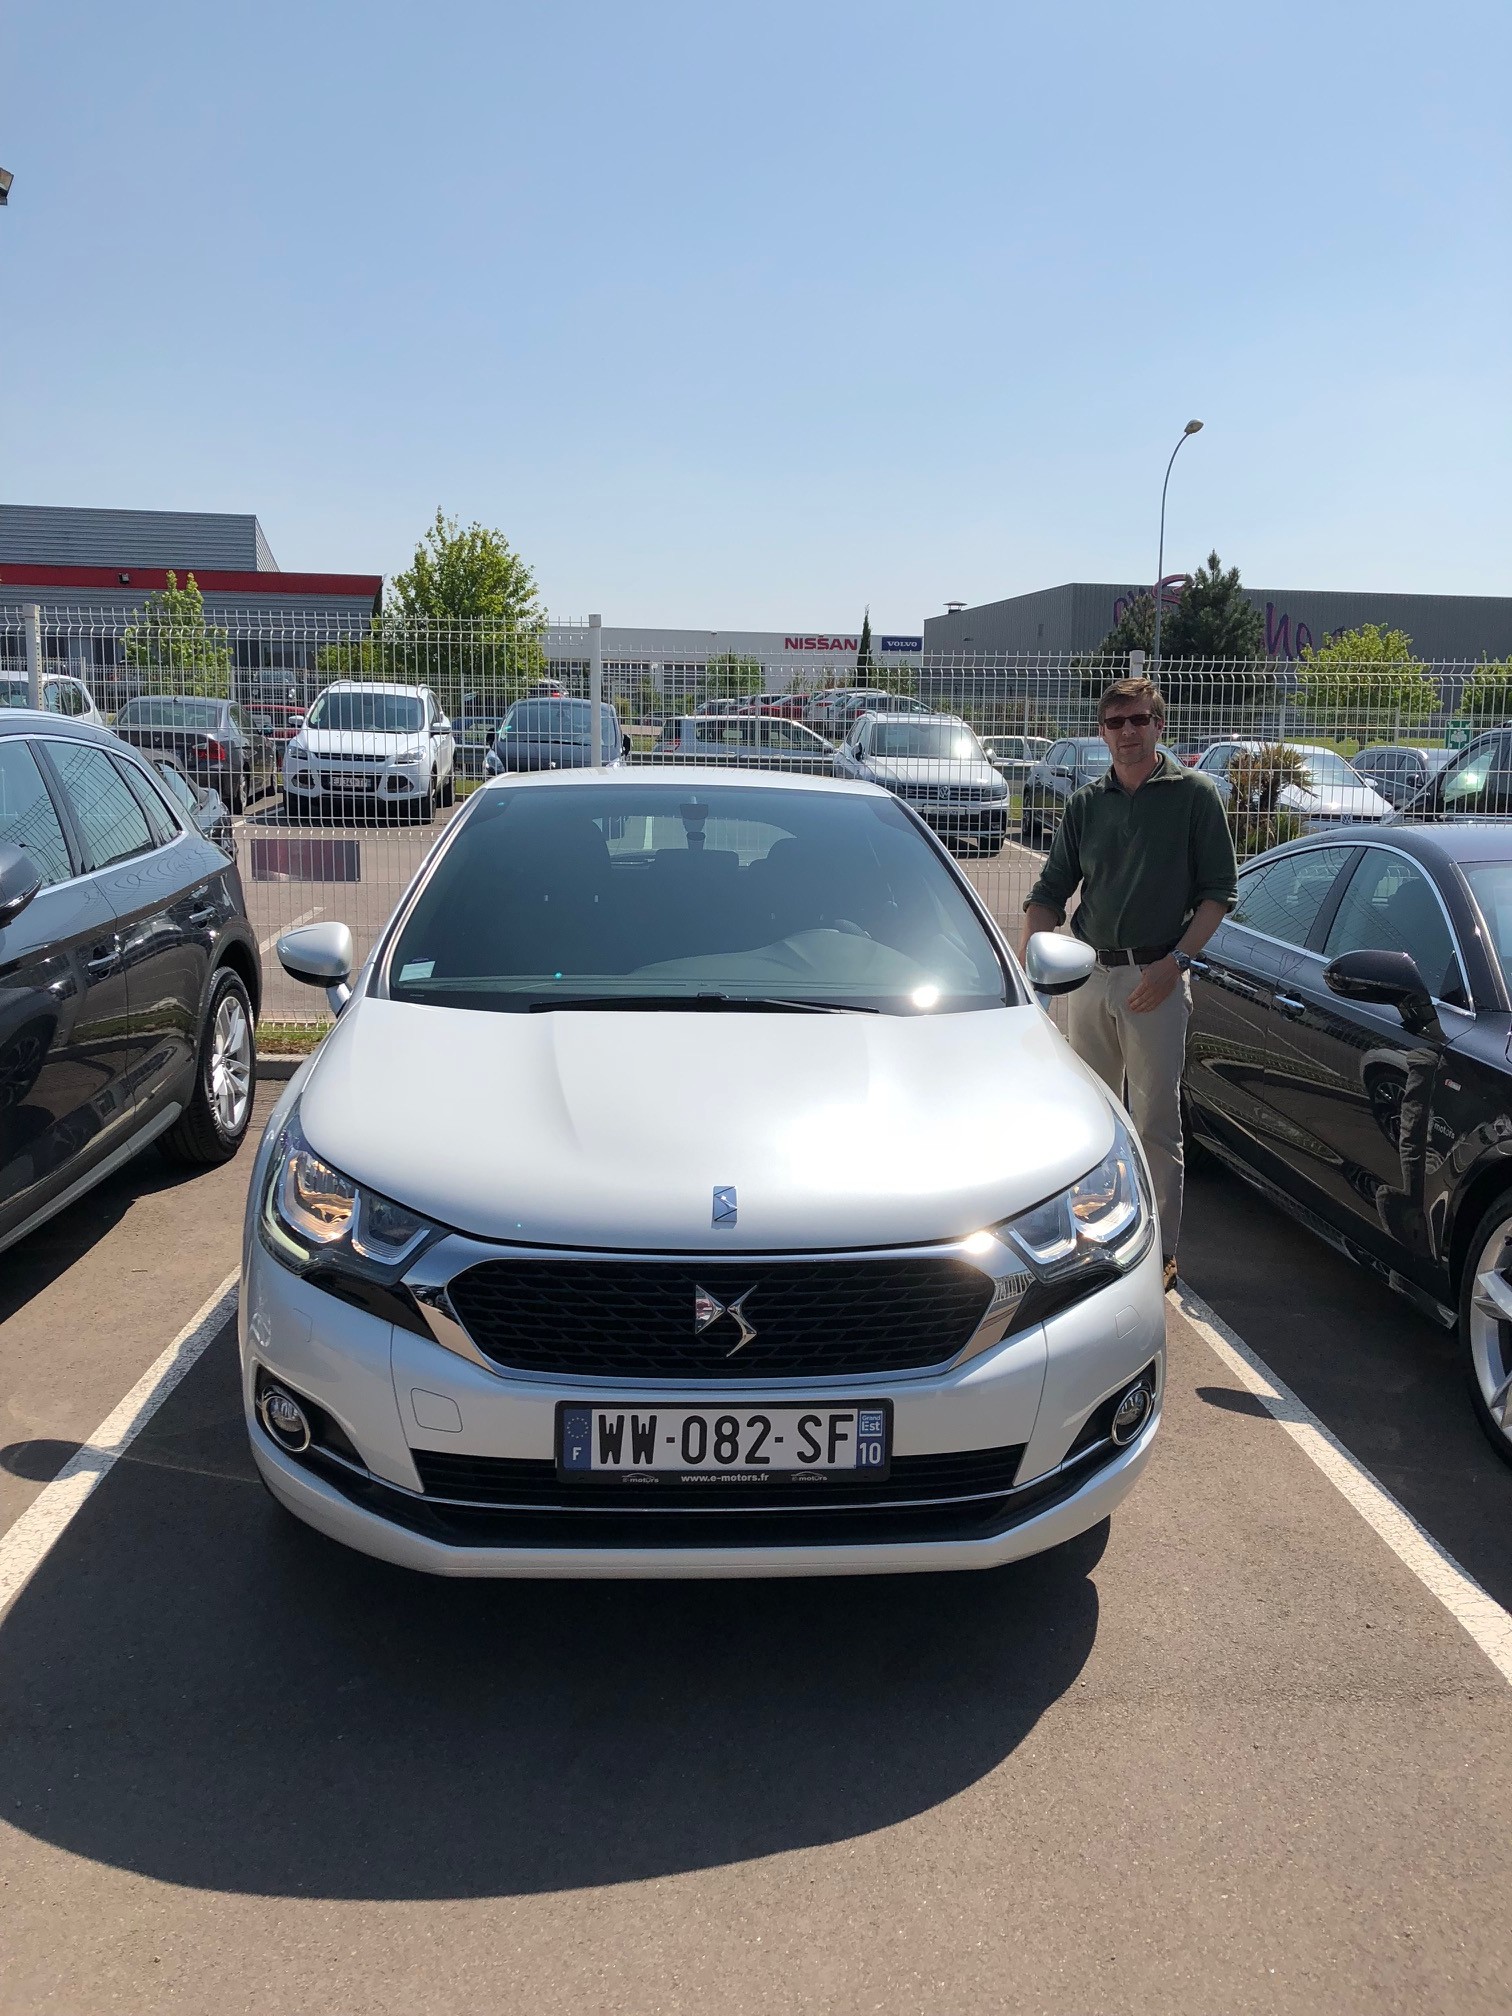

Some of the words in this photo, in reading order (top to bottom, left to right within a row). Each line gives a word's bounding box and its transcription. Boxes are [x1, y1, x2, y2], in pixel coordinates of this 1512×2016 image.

[785, 637, 857, 650] NISSAN
[887, 640, 918, 648] VOLVO
[861, 1420, 881, 1431] Est
[572, 1446, 582, 1461] F
[859, 1442, 882, 1465] 10
[681, 1473, 770, 1483] www.e-motors.fr
